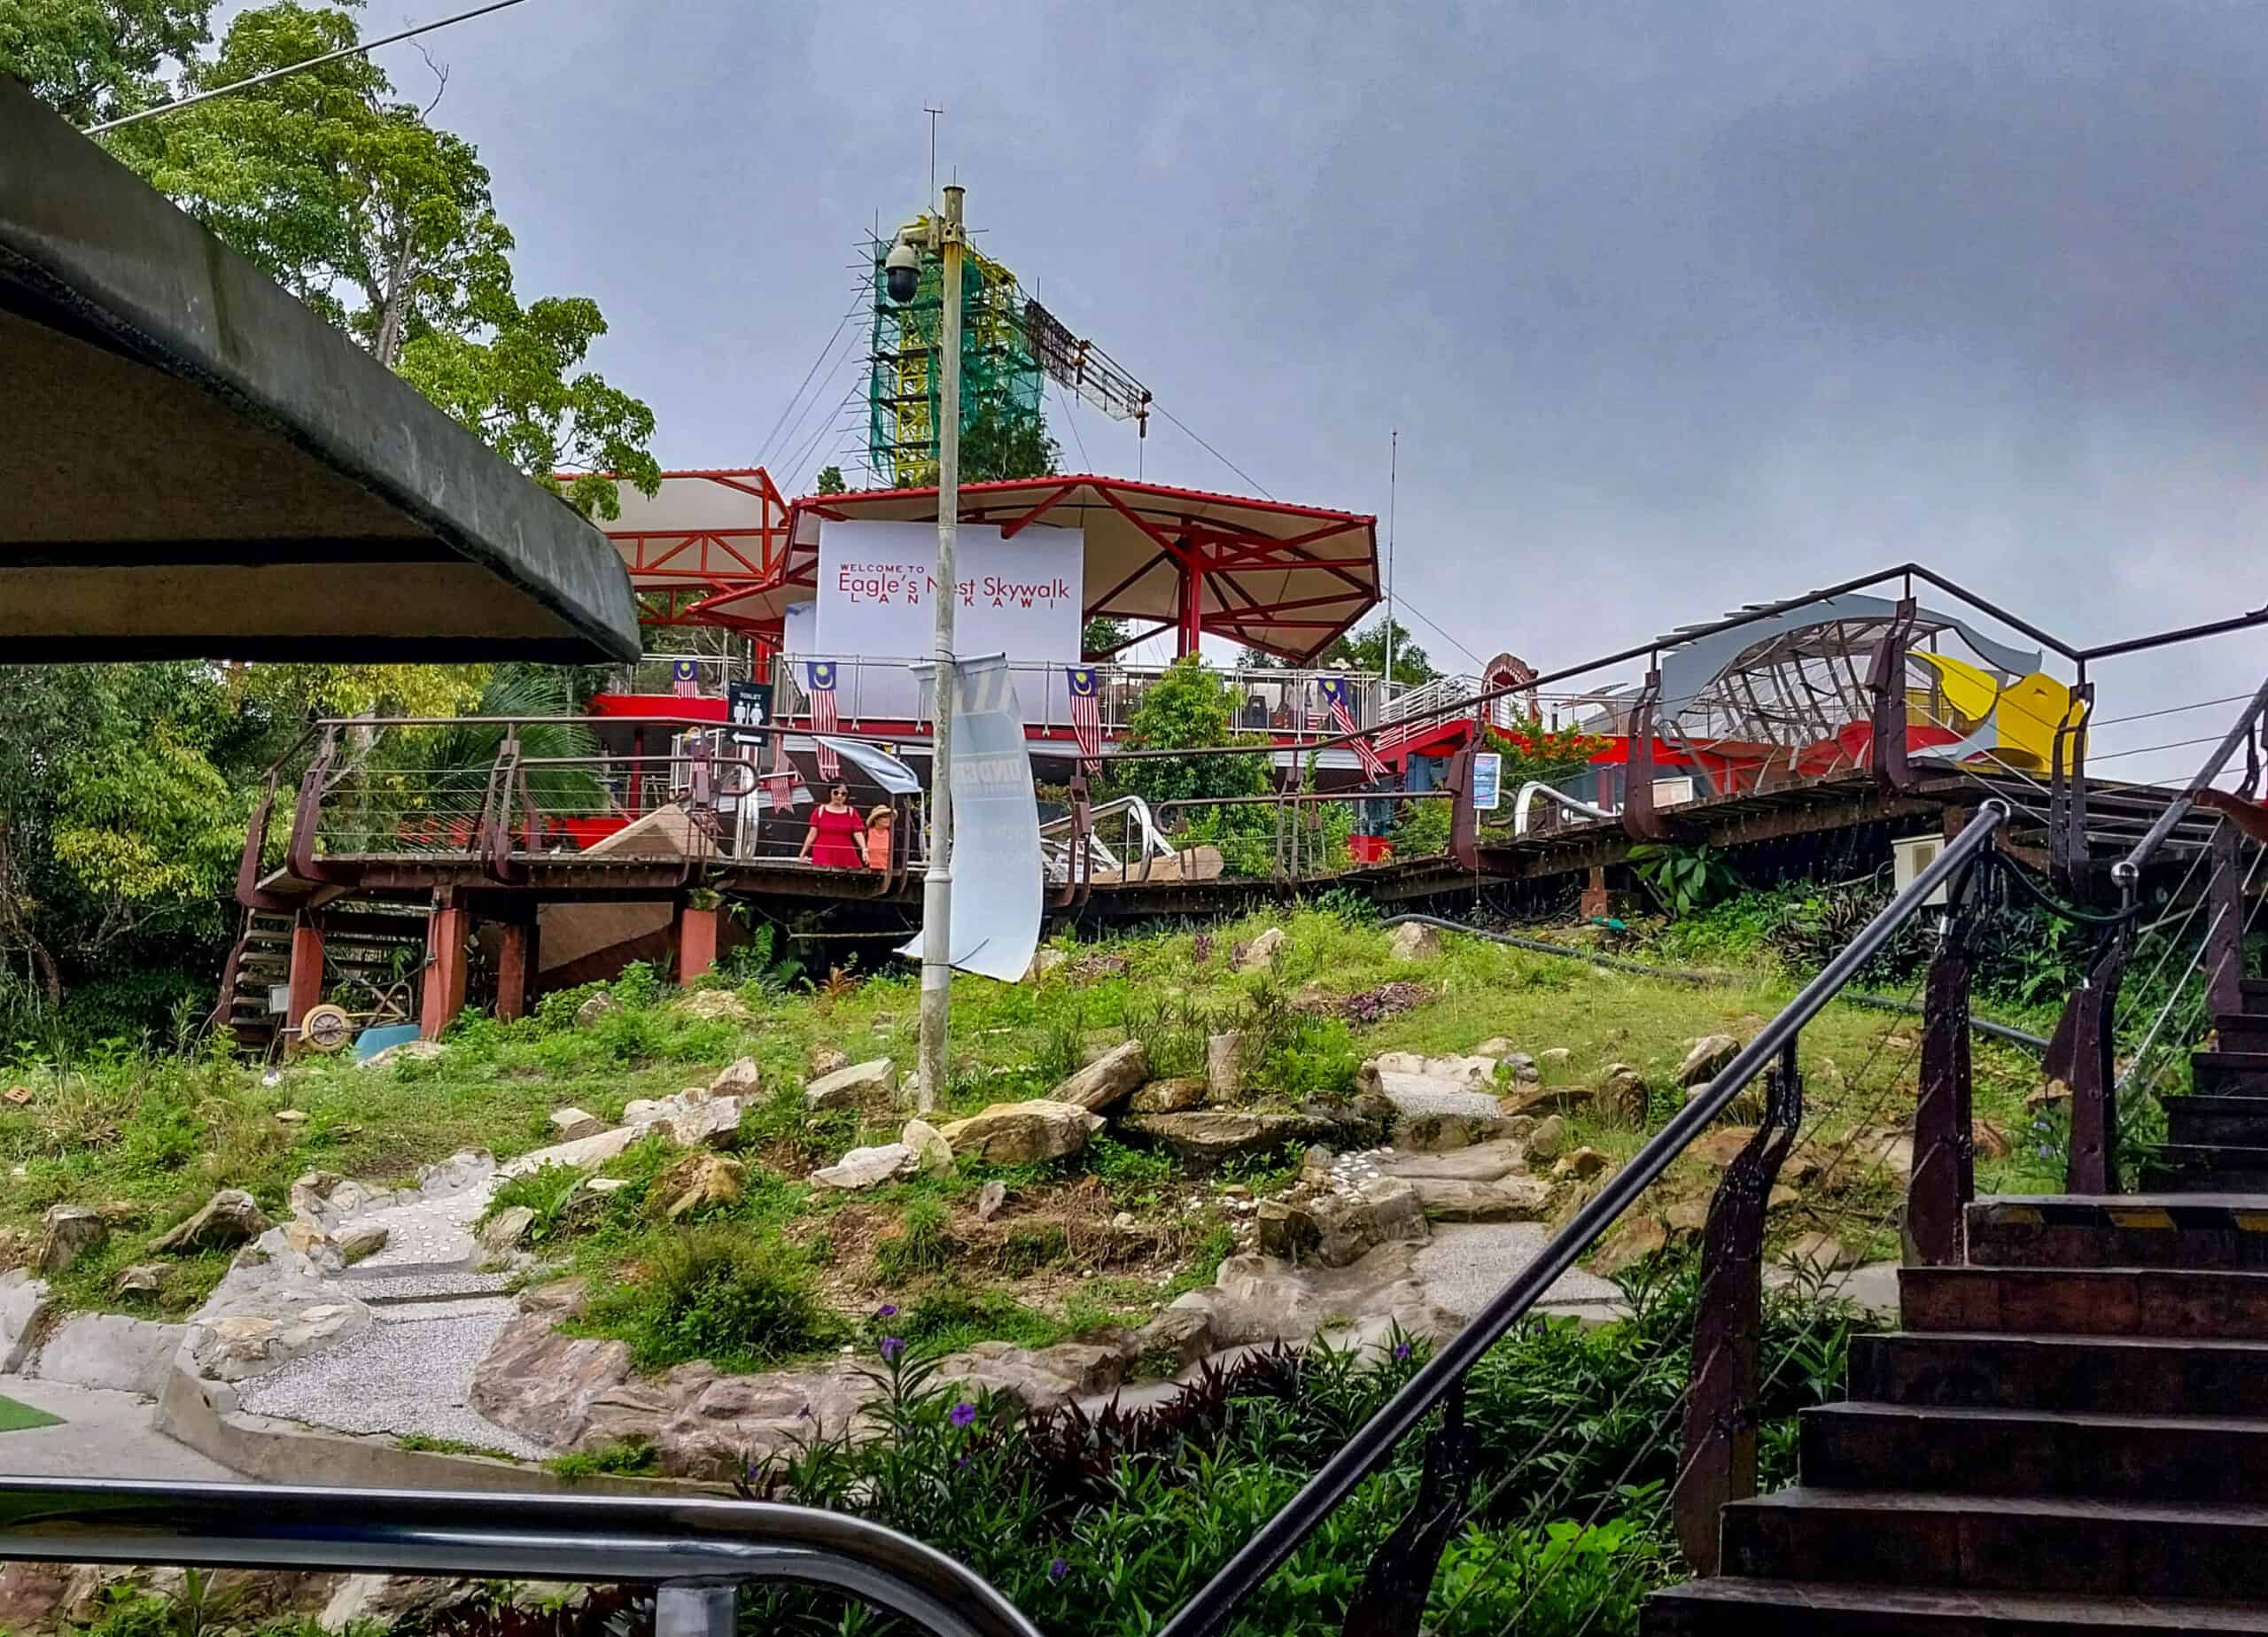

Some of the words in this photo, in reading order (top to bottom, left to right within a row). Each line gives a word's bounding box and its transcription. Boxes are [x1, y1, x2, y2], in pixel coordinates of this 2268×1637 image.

[840, 563, 903, 573] WELCOME
[907, 565, 925, 574] TO
[839, 572, 918, 597] Eagle's
[927, 575, 976, 596] Nst
[983, 577, 1070, 601] Skywalk
[851, 593, 1054, 609] LANKAWI
[739, 691, 762, 700] TOILET
